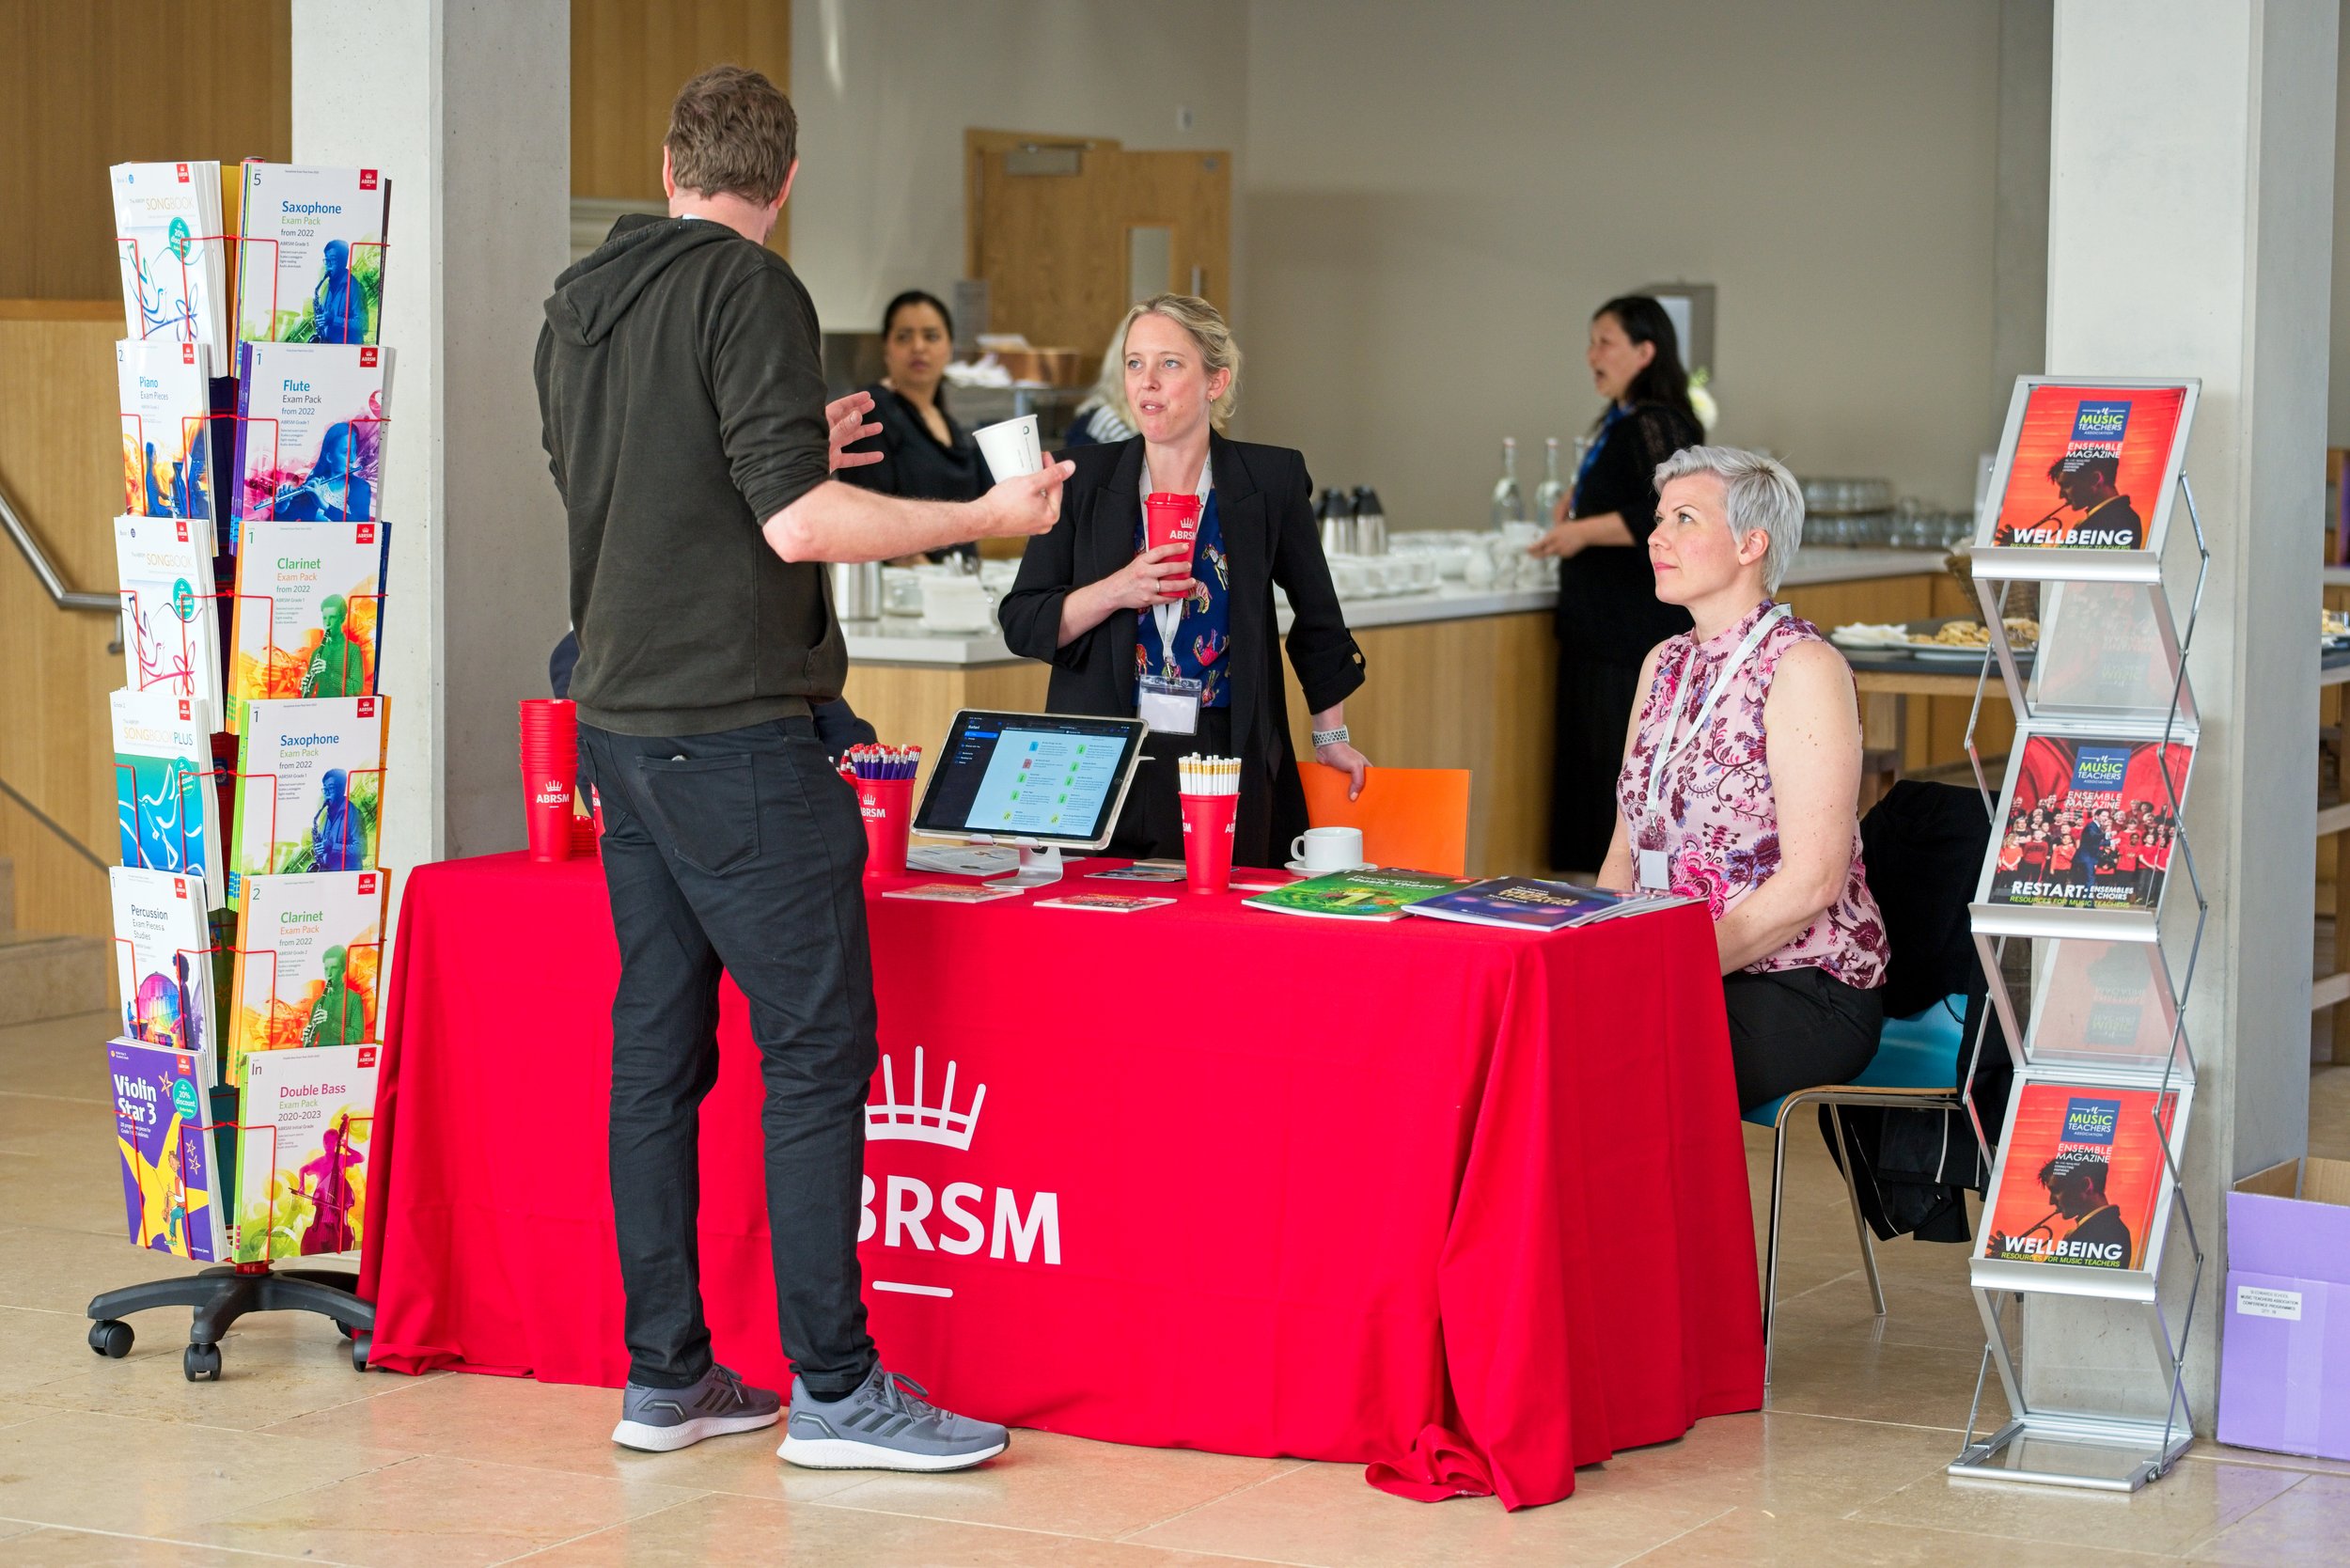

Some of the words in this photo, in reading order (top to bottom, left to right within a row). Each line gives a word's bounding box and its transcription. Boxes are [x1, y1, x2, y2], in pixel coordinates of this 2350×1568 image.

[254, 173, 261, 186] 5
[146, 197, 195, 212] SONGBOOK
[282, 200, 342, 215] Saxophone
[282, 216, 302, 225] Exam
[304, 216, 321, 226] Pack
[281, 228, 296, 237] from
[118, 349, 124, 362] 2
[257, 353, 261, 365] 1
[139, 376, 159, 388] Piano
[283, 380, 310, 391] Flute
[140, 391, 153, 400] Exam
[154, 391, 168, 400] Pieces
[282, 395, 303, 403] Exam
[305, 395, 321, 403] Pack
[281, 407, 297, 416] from
[2079, 414, 2124, 425] MUSIC
[2078, 423, 2123, 431] TEACHERS
[2068, 442, 2123, 451] ENSEMBLE
[2065, 450, 2122, 459] MAGAZINE
[248, 531, 254, 544] 1
[1169, 530, 1197, 541] ABRSM
[2013, 527, 2134, 545] WELLBEING
[277, 557, 321, 570] Clarinet
[277, 572, 298, 581] Exam
[300, 572, 318, 581] Pack
[276, 585, 292, 593] from
[254, 711, 258, 723] 1
[174, 731, 194, 745] PLUS
[280, 733, 339, 747] Saxophone
[280, 749, 301, 758] Exam
[279, 761, 294, 770] from
[2078, 762, 2123, 774] MUSIC
[2078, 772, 2122, 780] TEACHERS
[536, 793, 570, 804] ABRSM
[2067, 791, 2123, 802] ENSEMBLE
[2064, 799, 2121, 809] MAGAZINE
[861, 808, 886, 818] BRSM
[252, 888, 260, 901] 2
[2012, 881, 2089, 899] RESTART:
[2090, 886, 2134, 894] ENSEMBLES
[2010, 895, 2051, 904] RESOURCES
[2069, 899, 2092, 907] MUSIC
[2096, 892, 2127, 901] CHOIRS
[131, 904, 168, 920] Percussion
[281, 911, 323, 923] Clarinet
[133, 918, 145, 928] Exam
[146, 920, 161, 931] Pieces
[280, 927, 301, 935] Exam
[303, 925, 320, 933] Pack
[133, 930, 151, 941] Studies
[279, 938, 294, 947] from
[252, 1063, 262, 1075] In
[114, 1074, 157, 1102] Violin
[280, 1085, 319, 1098] Double
[321, 1084, 346, 1094] Bass
[179, 1090, 191, 1099] 20%
[279, 1101, 300, 1109] Exam
[301, 1099, 319, 1107] Pack
[118, 1097, 145, 1122] Star
[147, 1102, 157, 1125] 3
[278, 1110, 321, 1121] 2020-2023
[2070, 1114, 2113, 1125] MUSIC
[2068, 1123, 2111, 1133] TEACHERS
[2058, 1143, 2112, 1155] ENSEMBLE
[2056, 1152, 2111, 1164] MAGAZINE
[2005, 1235, 2123, 1261] WELLBEING
[2000, 1252, 2043, 1262] RESOURCES
[2060, 1256, 2082, 1265] MUSIC
[2084, 1259, 2121, 1267] TEACHERS
